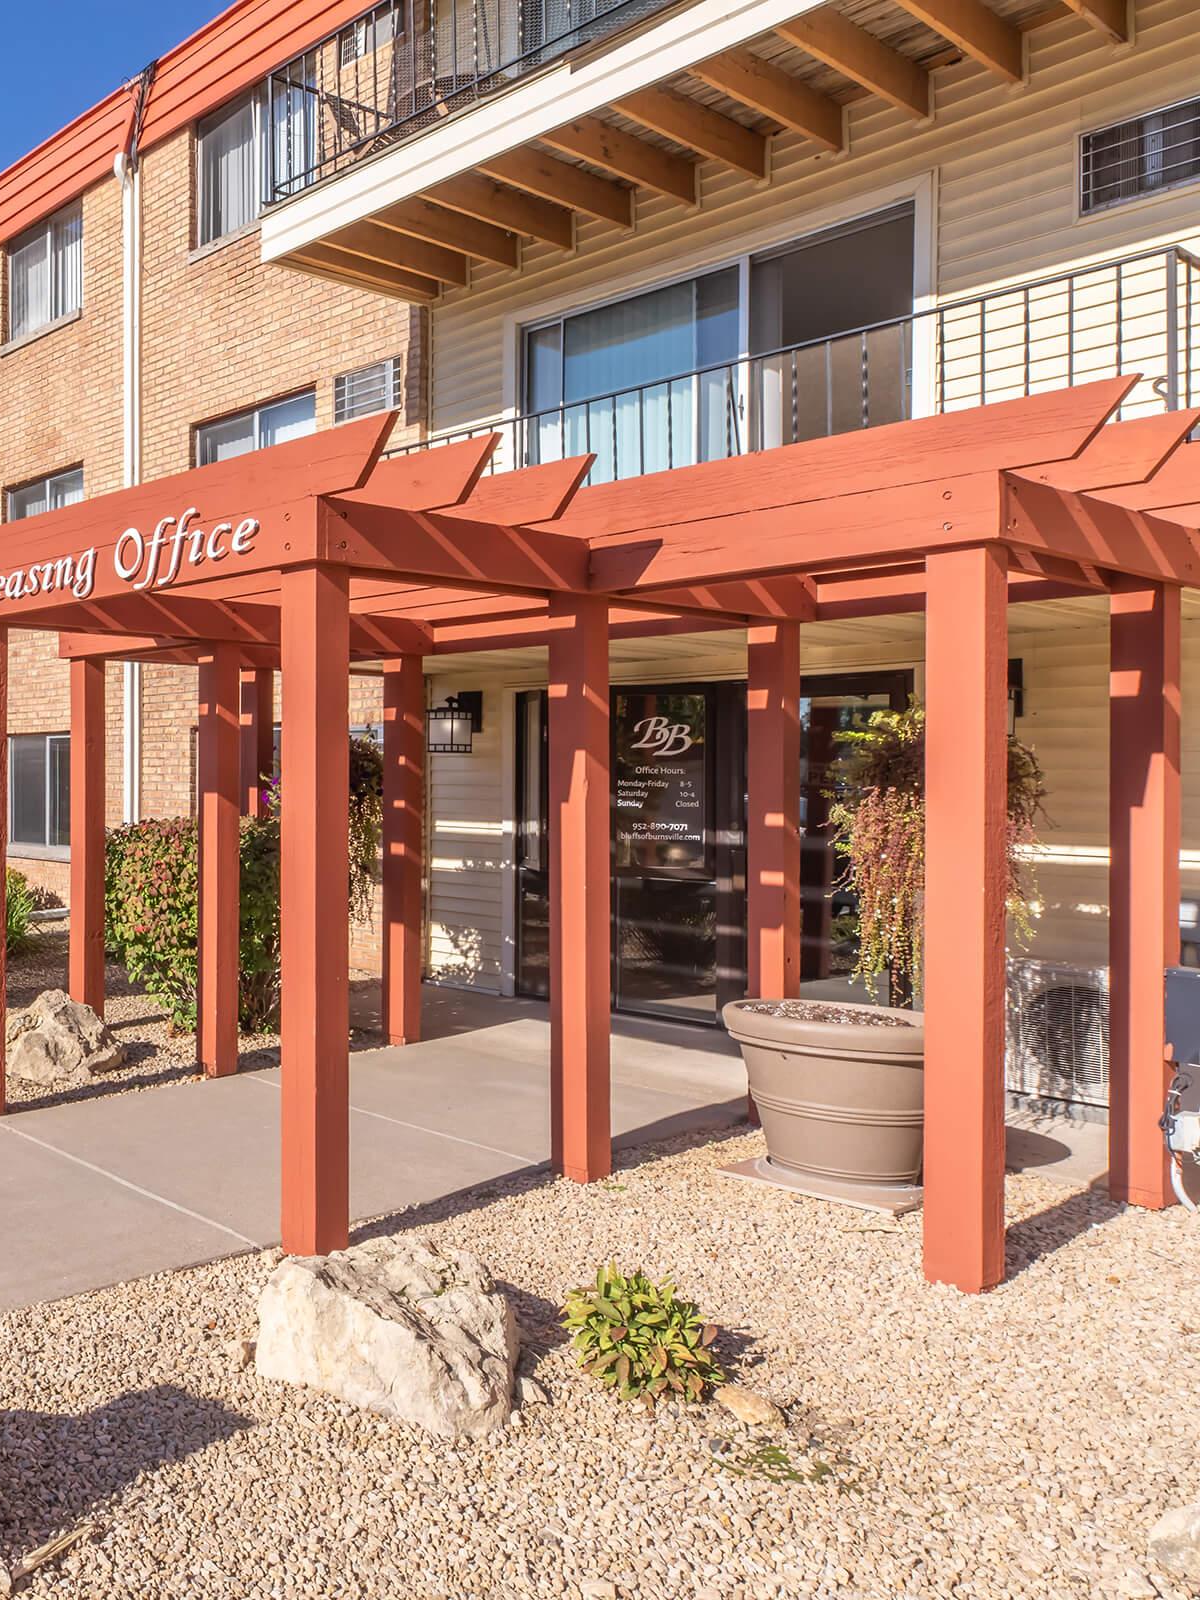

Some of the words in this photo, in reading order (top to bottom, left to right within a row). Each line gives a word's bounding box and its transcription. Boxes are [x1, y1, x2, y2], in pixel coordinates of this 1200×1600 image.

[113, 506, 259, 590] Office
[635, 766, 659, 774] Office
[617, 780, 669, 789] Monday-Friday
[617, 790, 649, 798] Saturday
[617, 799, 644, 808] Sunday
[675, 800, 700, 808] Closed
[632, 823, 688, 831] 952-890-7071
[620, 832, 701, 841] bluffsofburnsville.com
